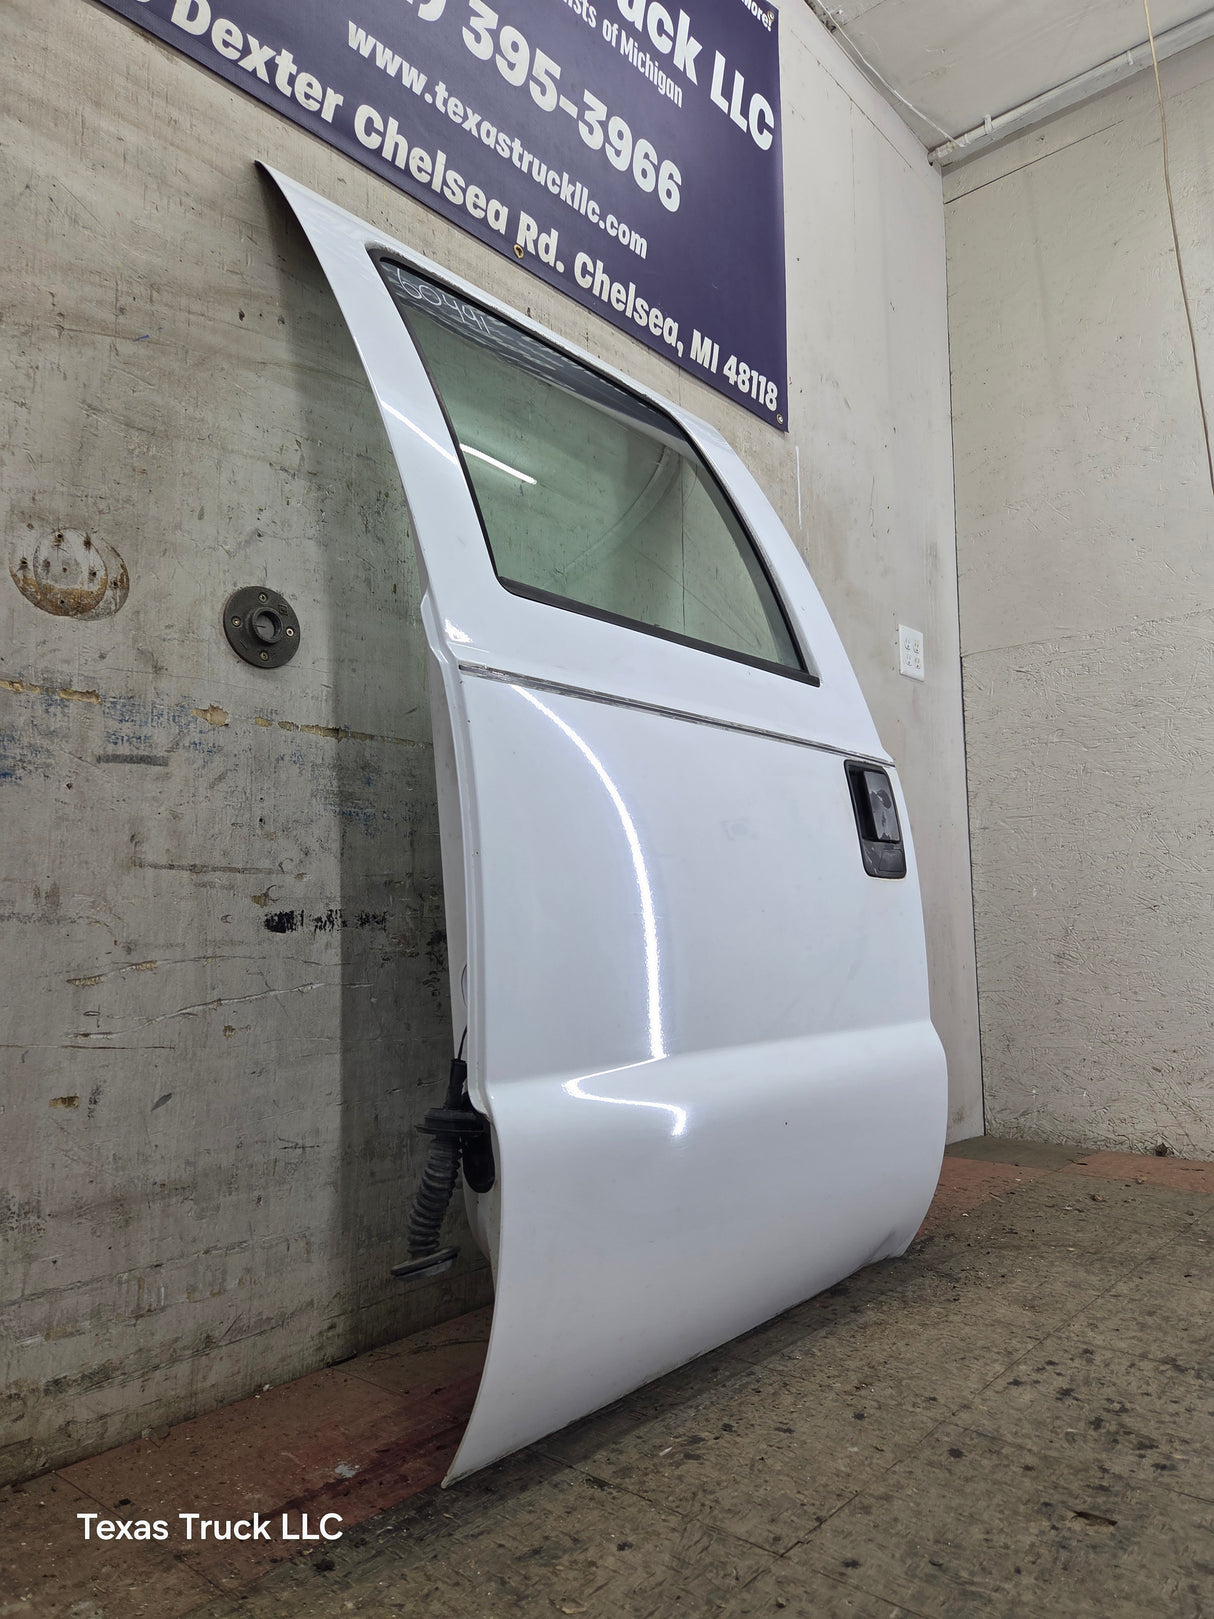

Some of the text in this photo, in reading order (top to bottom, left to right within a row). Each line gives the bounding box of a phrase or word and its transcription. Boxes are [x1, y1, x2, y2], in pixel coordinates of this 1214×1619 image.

[348, 20, 648, 260] www.texastruckllc.com
[462, 0, 682, 213] 395-3966
[602, 18, 619, 48] of
[619, 29, 683, 108] Michigan
[710, 50, 774, 151] LLC
[170, 0, 778, 412] Dexter Chelsea Rd. Chelsea, MI 48118
